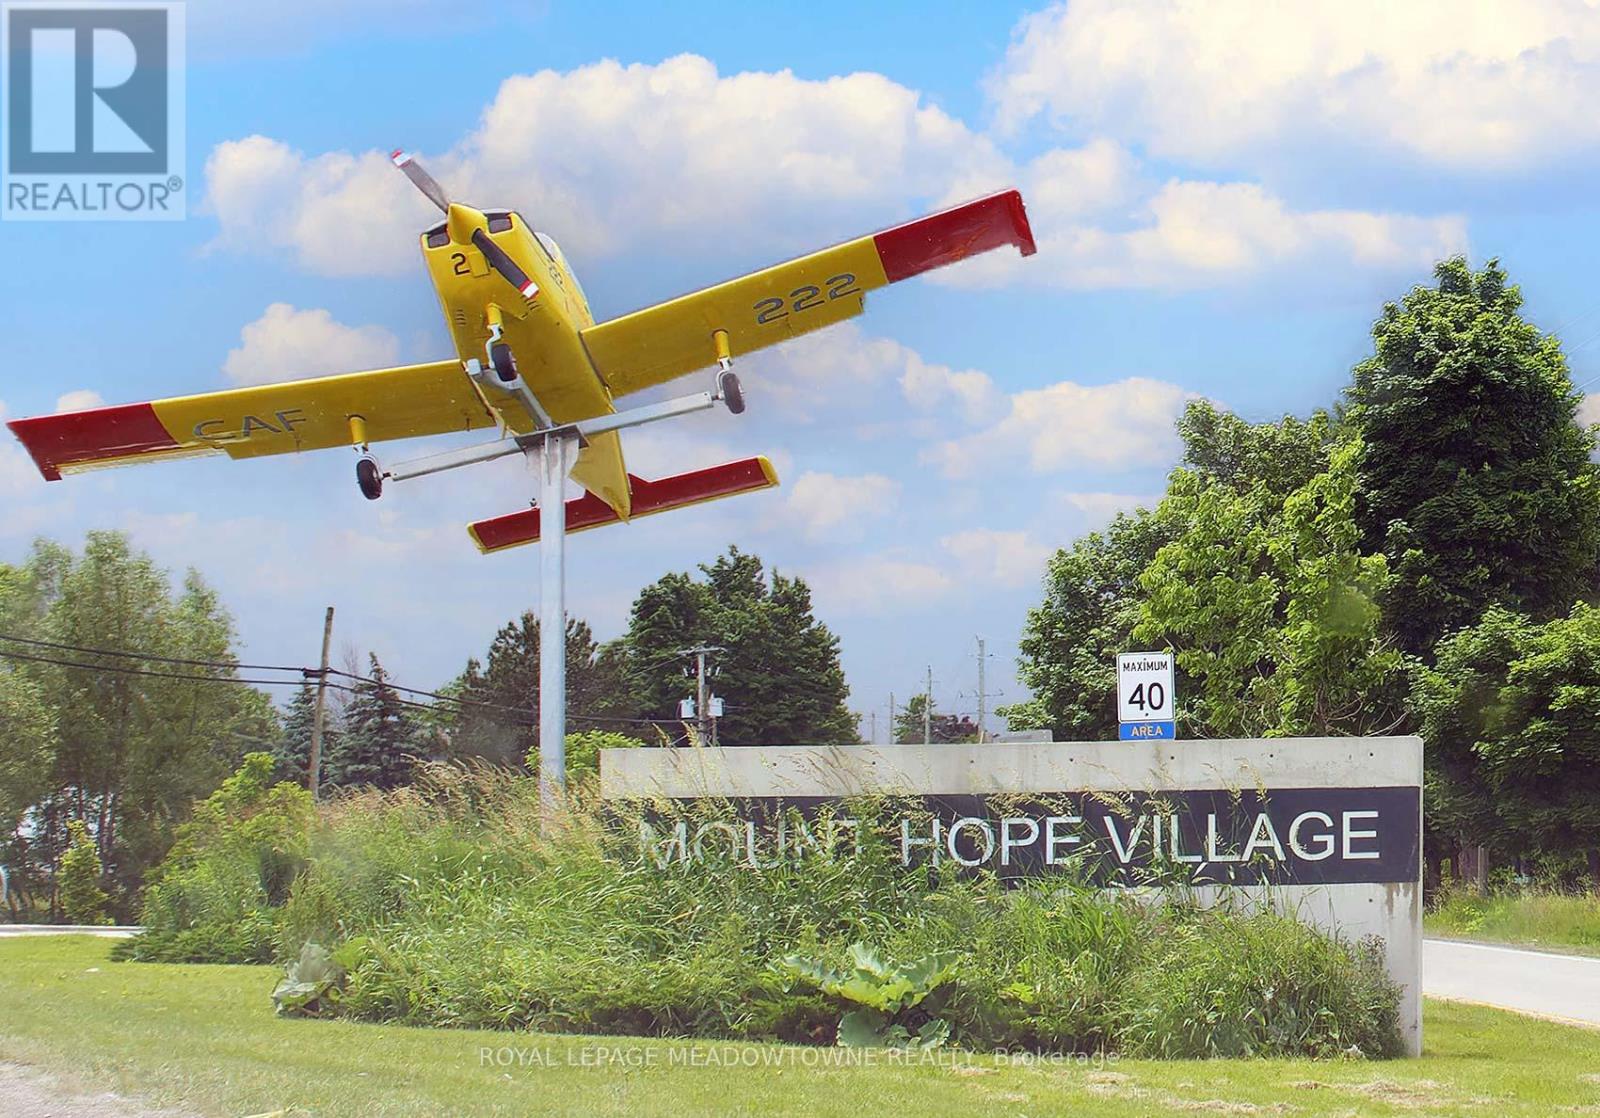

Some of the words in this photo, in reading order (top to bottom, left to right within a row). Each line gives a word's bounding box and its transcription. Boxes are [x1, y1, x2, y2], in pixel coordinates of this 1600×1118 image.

[451, 252, 471, 276] 2
[752, 273, 861, 325] 222
[192, 409, 307, 440] CAF
[1122, 661, 1168, 672] MAXIMUM
[1128, 682, 1165, 711] 40
[1131, 726, 1163, 737] AREA
[900, 816, 1083, 867] HOPE
[1103, 810, 1380, 864] VILLAGE
